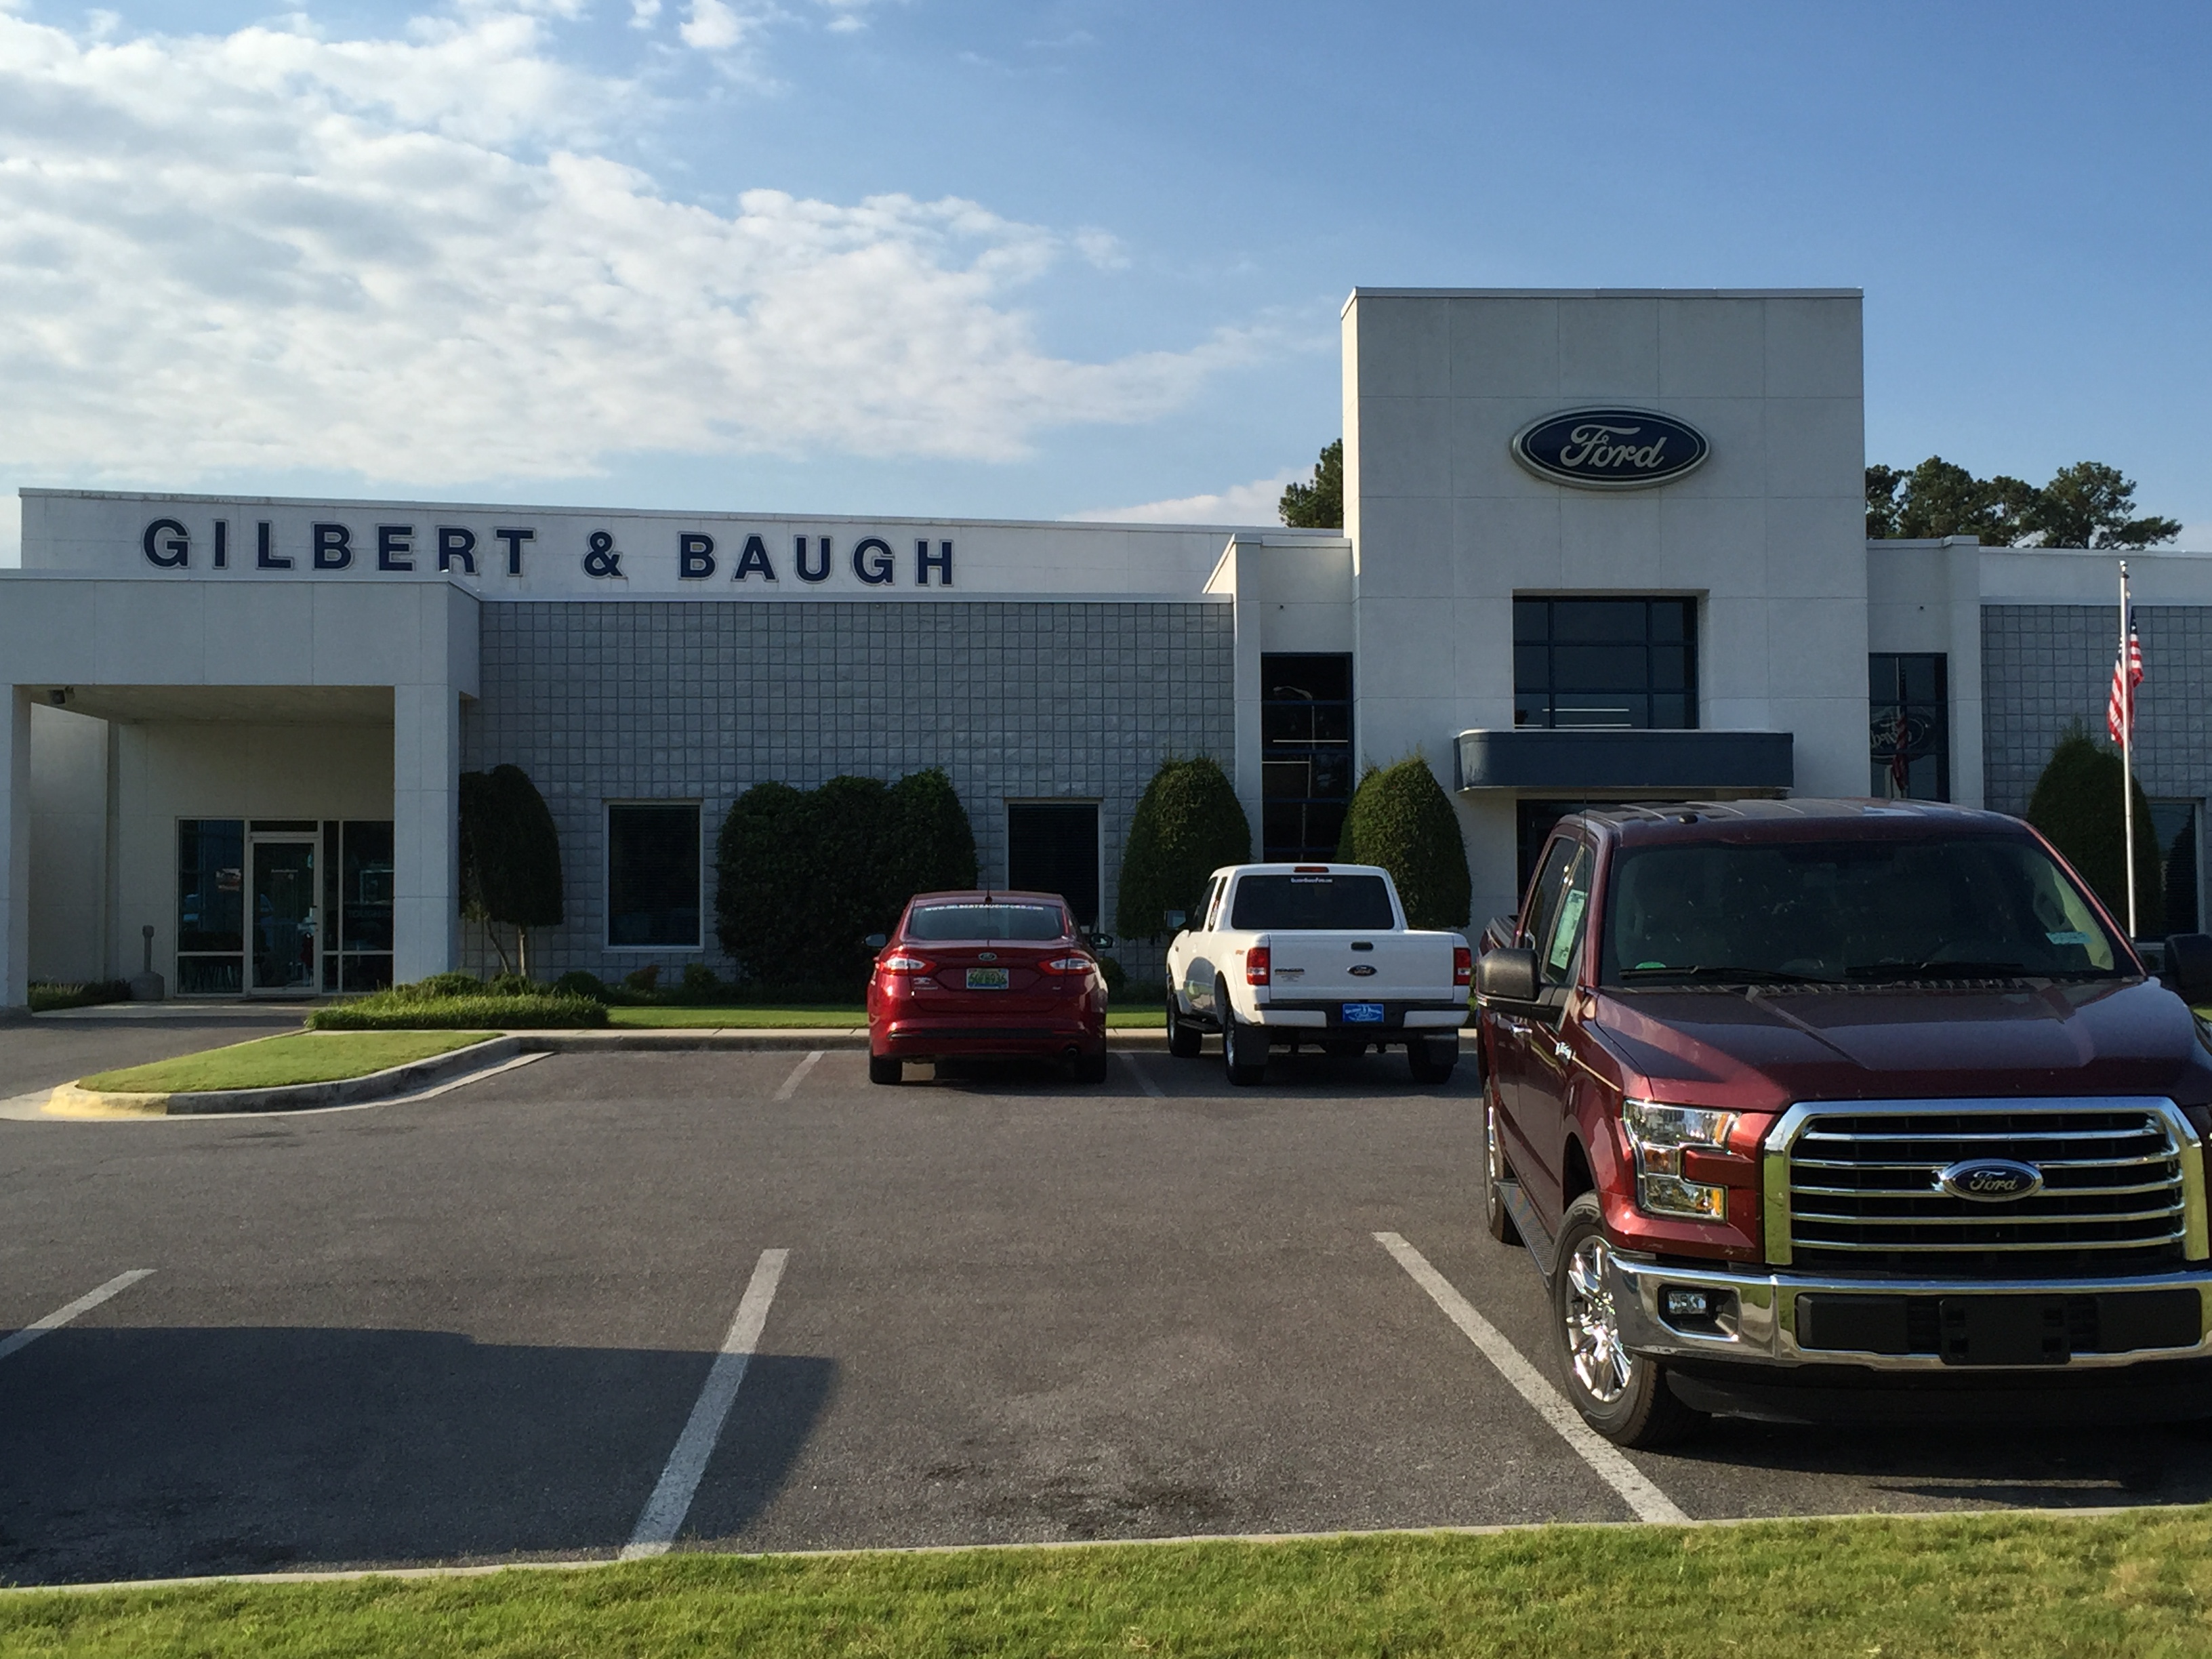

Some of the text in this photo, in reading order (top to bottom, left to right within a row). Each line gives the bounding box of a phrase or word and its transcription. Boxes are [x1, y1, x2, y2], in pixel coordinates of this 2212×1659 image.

[1560, 424, 1667, 468] Ford
[142, 516, 954, 587] GILBERT & BAUGH
[1969, 1170, 2018, 1191] Ford
